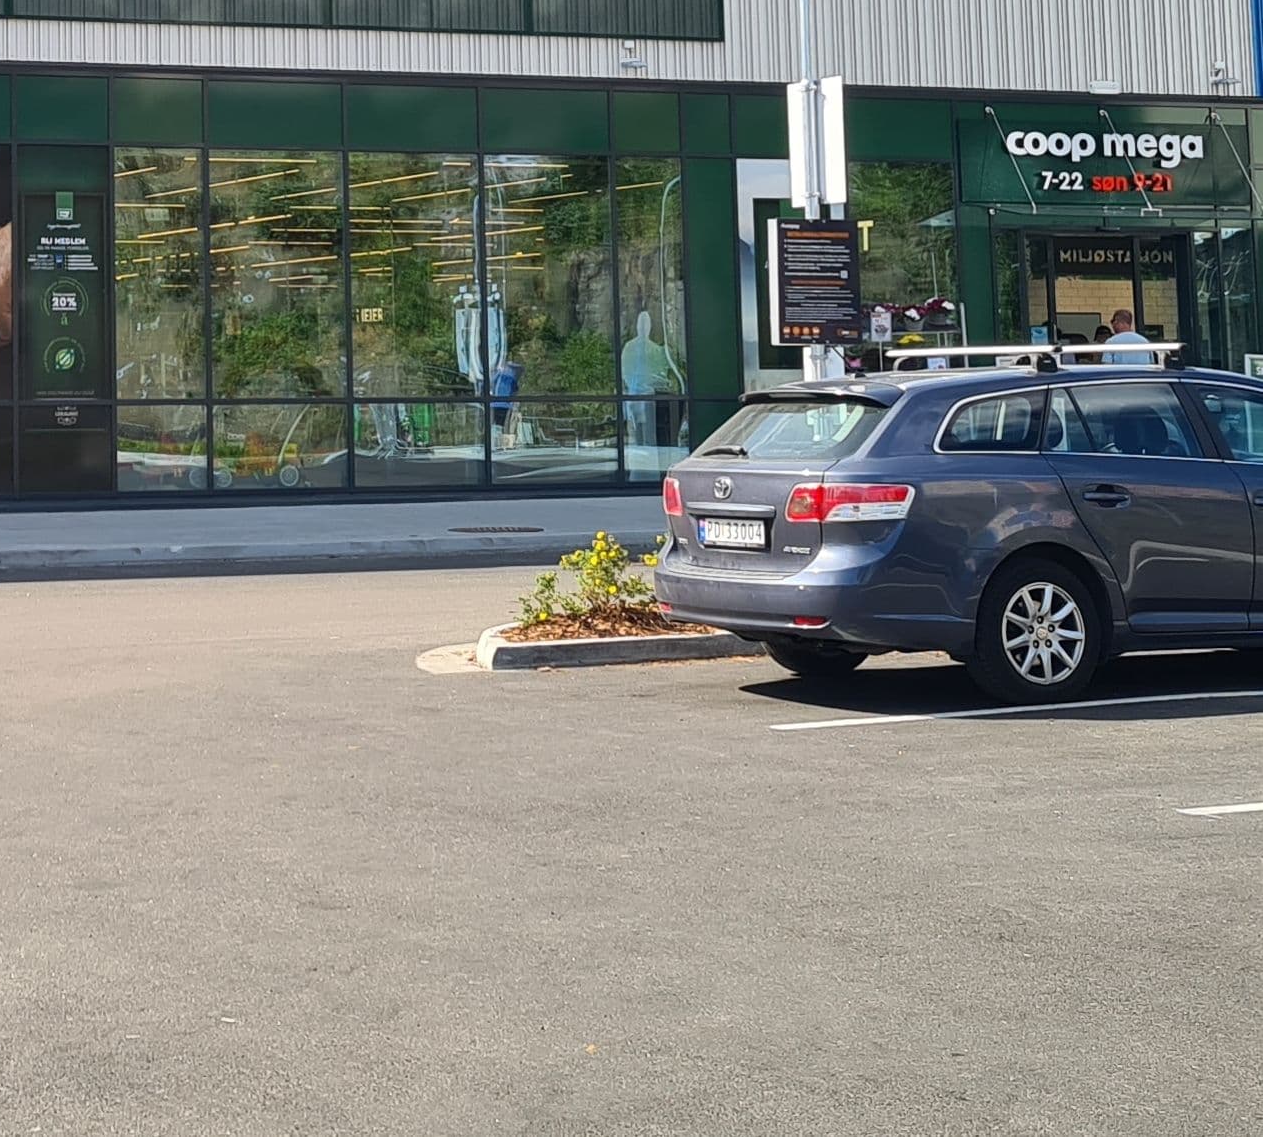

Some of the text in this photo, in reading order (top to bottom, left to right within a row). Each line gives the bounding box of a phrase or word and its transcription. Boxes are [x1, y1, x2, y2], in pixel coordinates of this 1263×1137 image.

[1006, 130, 1204, 169] coop mega
[1041, 171, 1173, 193] 7-22 søn 9-21
